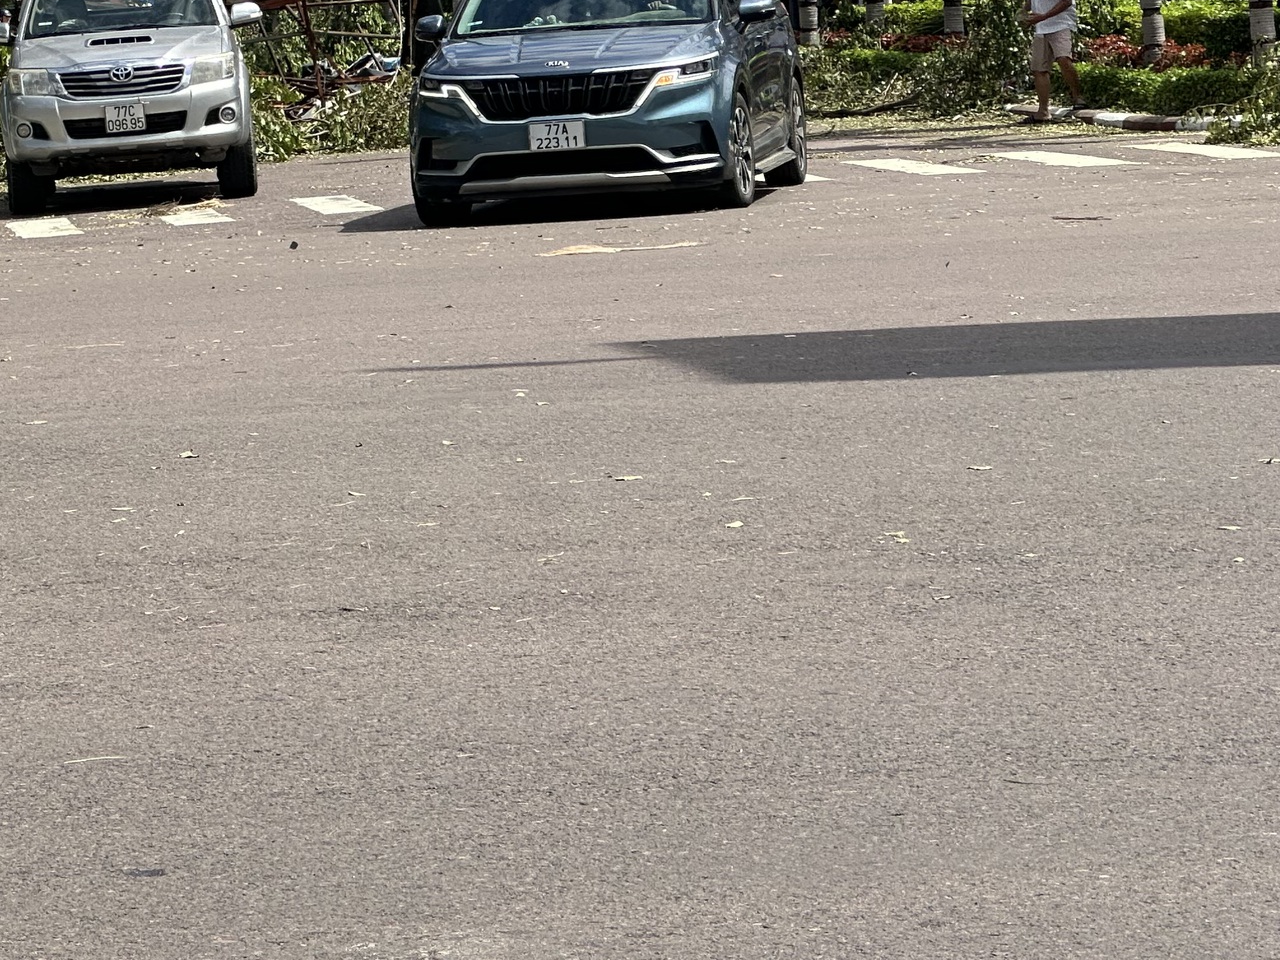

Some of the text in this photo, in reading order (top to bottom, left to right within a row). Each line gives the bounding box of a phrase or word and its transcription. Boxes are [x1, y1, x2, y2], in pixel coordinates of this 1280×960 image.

[114, 105, 135, 118] 77C
[107, 117, 144, 131] 096.95
[545, 123, 568, 136] 77A
[536, 135, 578, 150] 223.11
